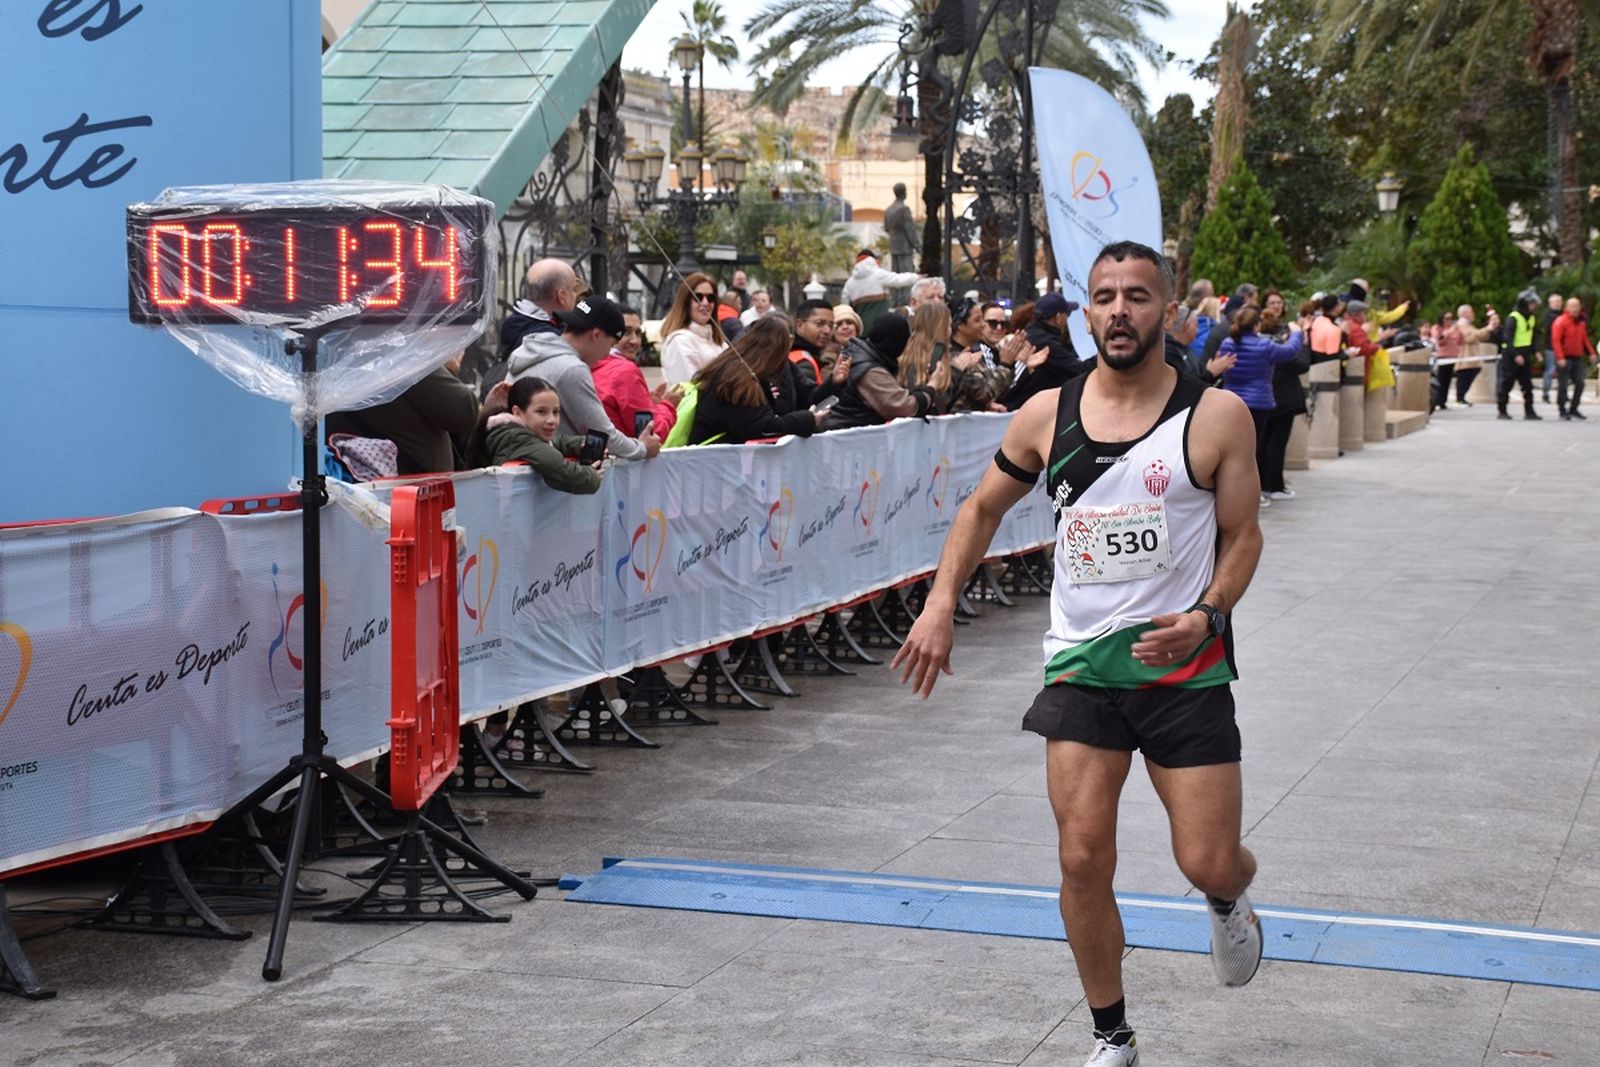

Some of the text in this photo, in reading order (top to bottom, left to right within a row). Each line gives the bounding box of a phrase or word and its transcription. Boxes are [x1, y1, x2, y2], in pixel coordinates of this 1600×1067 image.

[148, 223, 460, 306] 00:11:34
[1106, 529, 1158, 556] 530
[342, 618, 375, 662] Ceuta
[67, 621, 251, 727] Ceuta es Deporte
